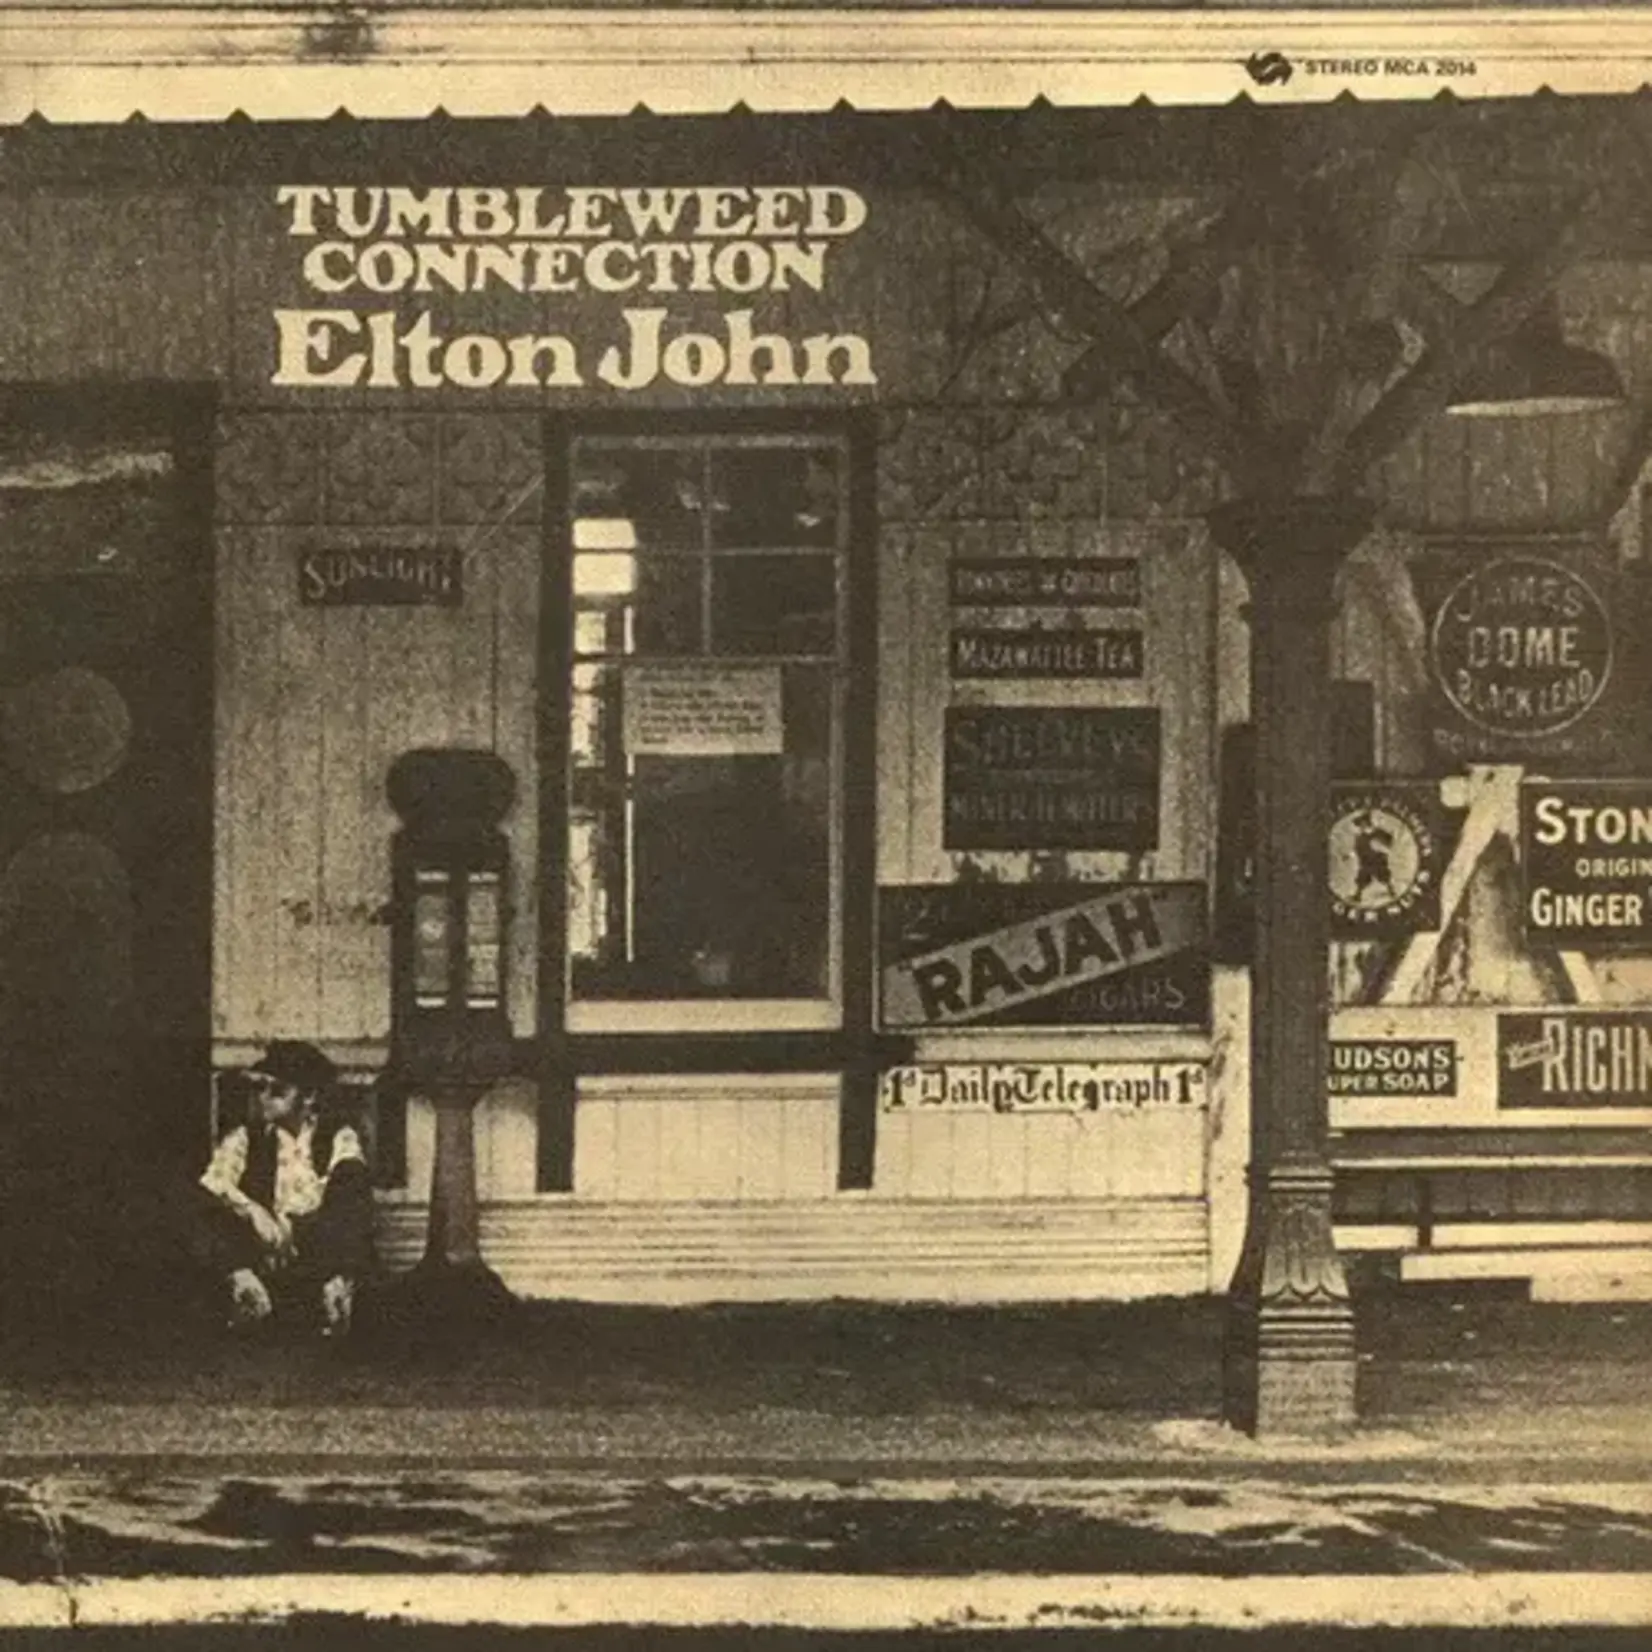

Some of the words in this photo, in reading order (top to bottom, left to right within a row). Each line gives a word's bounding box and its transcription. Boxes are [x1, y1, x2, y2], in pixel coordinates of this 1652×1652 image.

[1456, 576, 1585, 623] JAMES
[1468, 626, 1581, 668] DOME
[1538, 669, 1594, 716] LEAD
[1535, 797, 1652, 844] STON
[1531, 887, 1644, 927] GINGER
[912, 891, 1161, 1021] RAJAH
[919, 1066, 1013, 1113] Daily
[1013, 1066, 1170, 1111] Telegraph
[1382, 1072, 1450, 1092] SOAP
